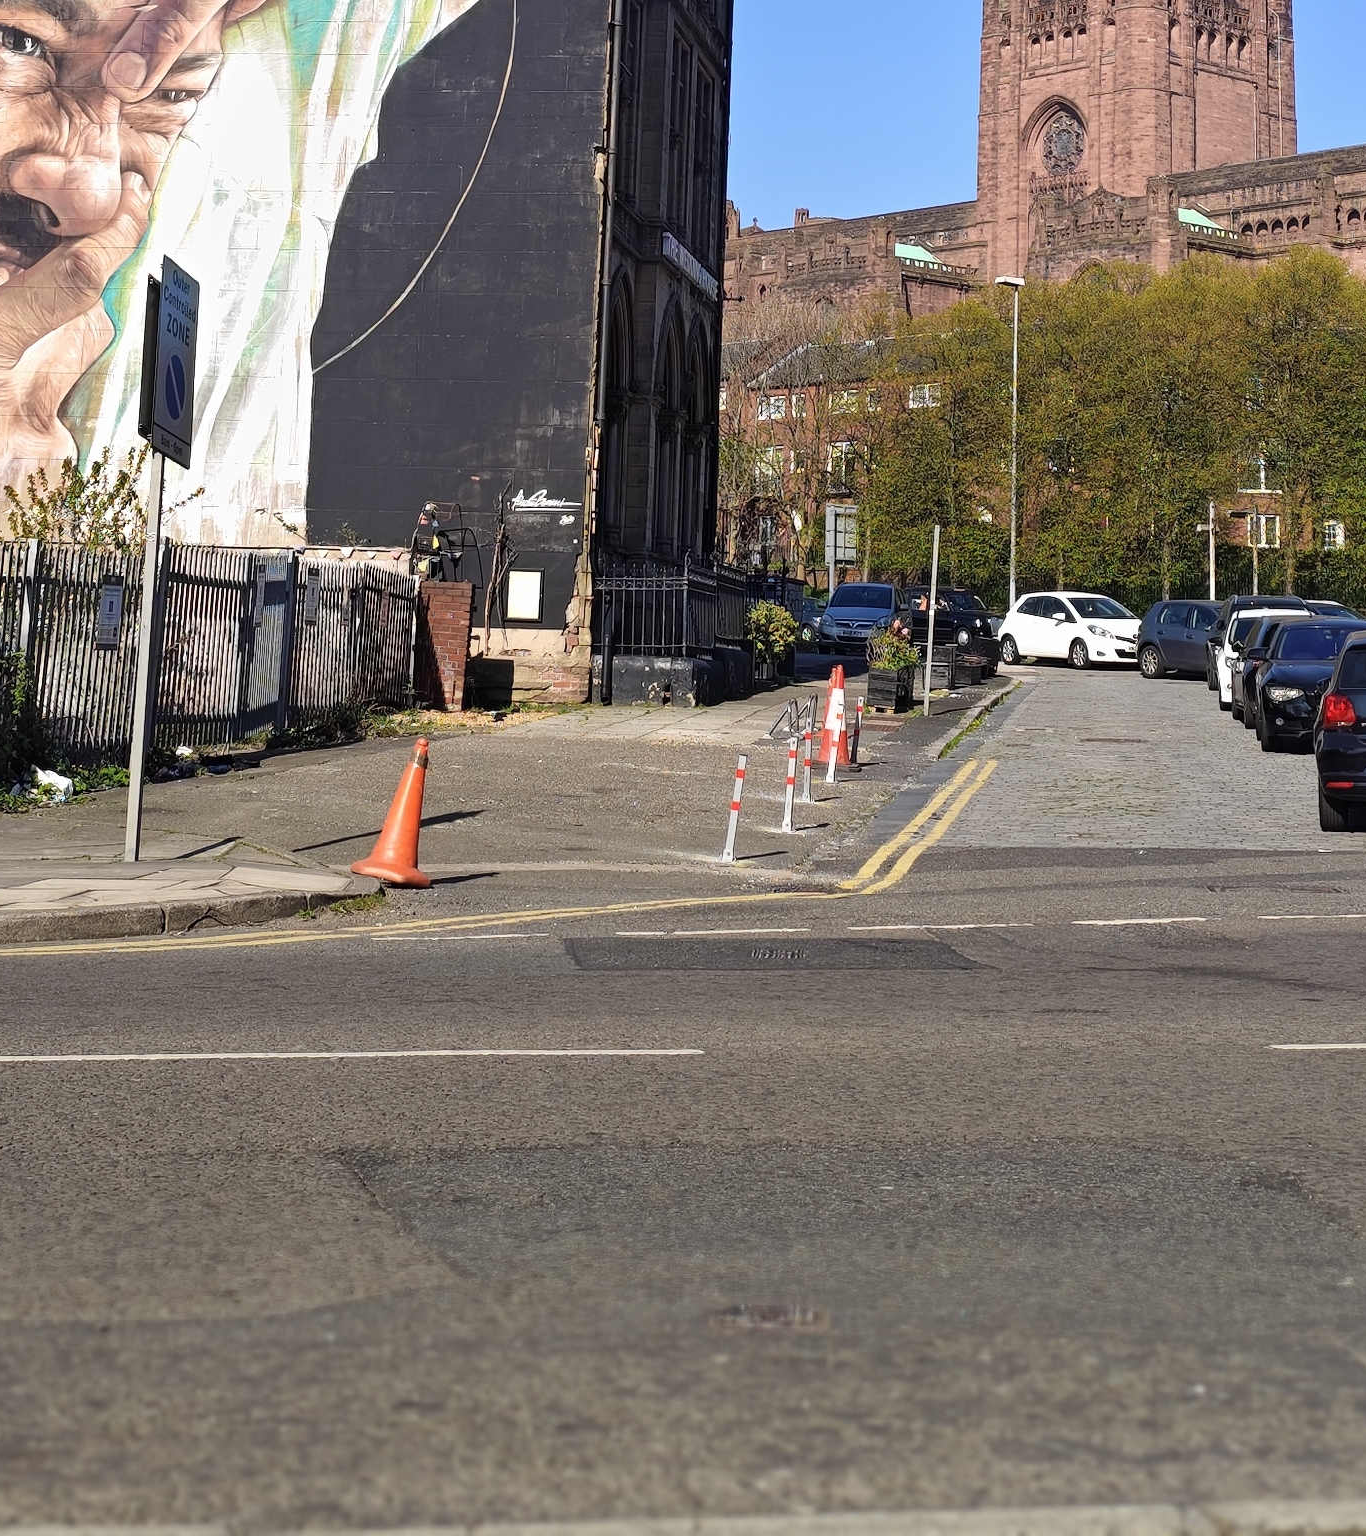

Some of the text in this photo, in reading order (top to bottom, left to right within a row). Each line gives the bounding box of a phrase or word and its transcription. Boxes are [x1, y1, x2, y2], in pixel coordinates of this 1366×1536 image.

[173, 269, 190, 296] Outer
[164, 285, 196, 323] Controlled
[167, 313, 189, 347] ZONE
